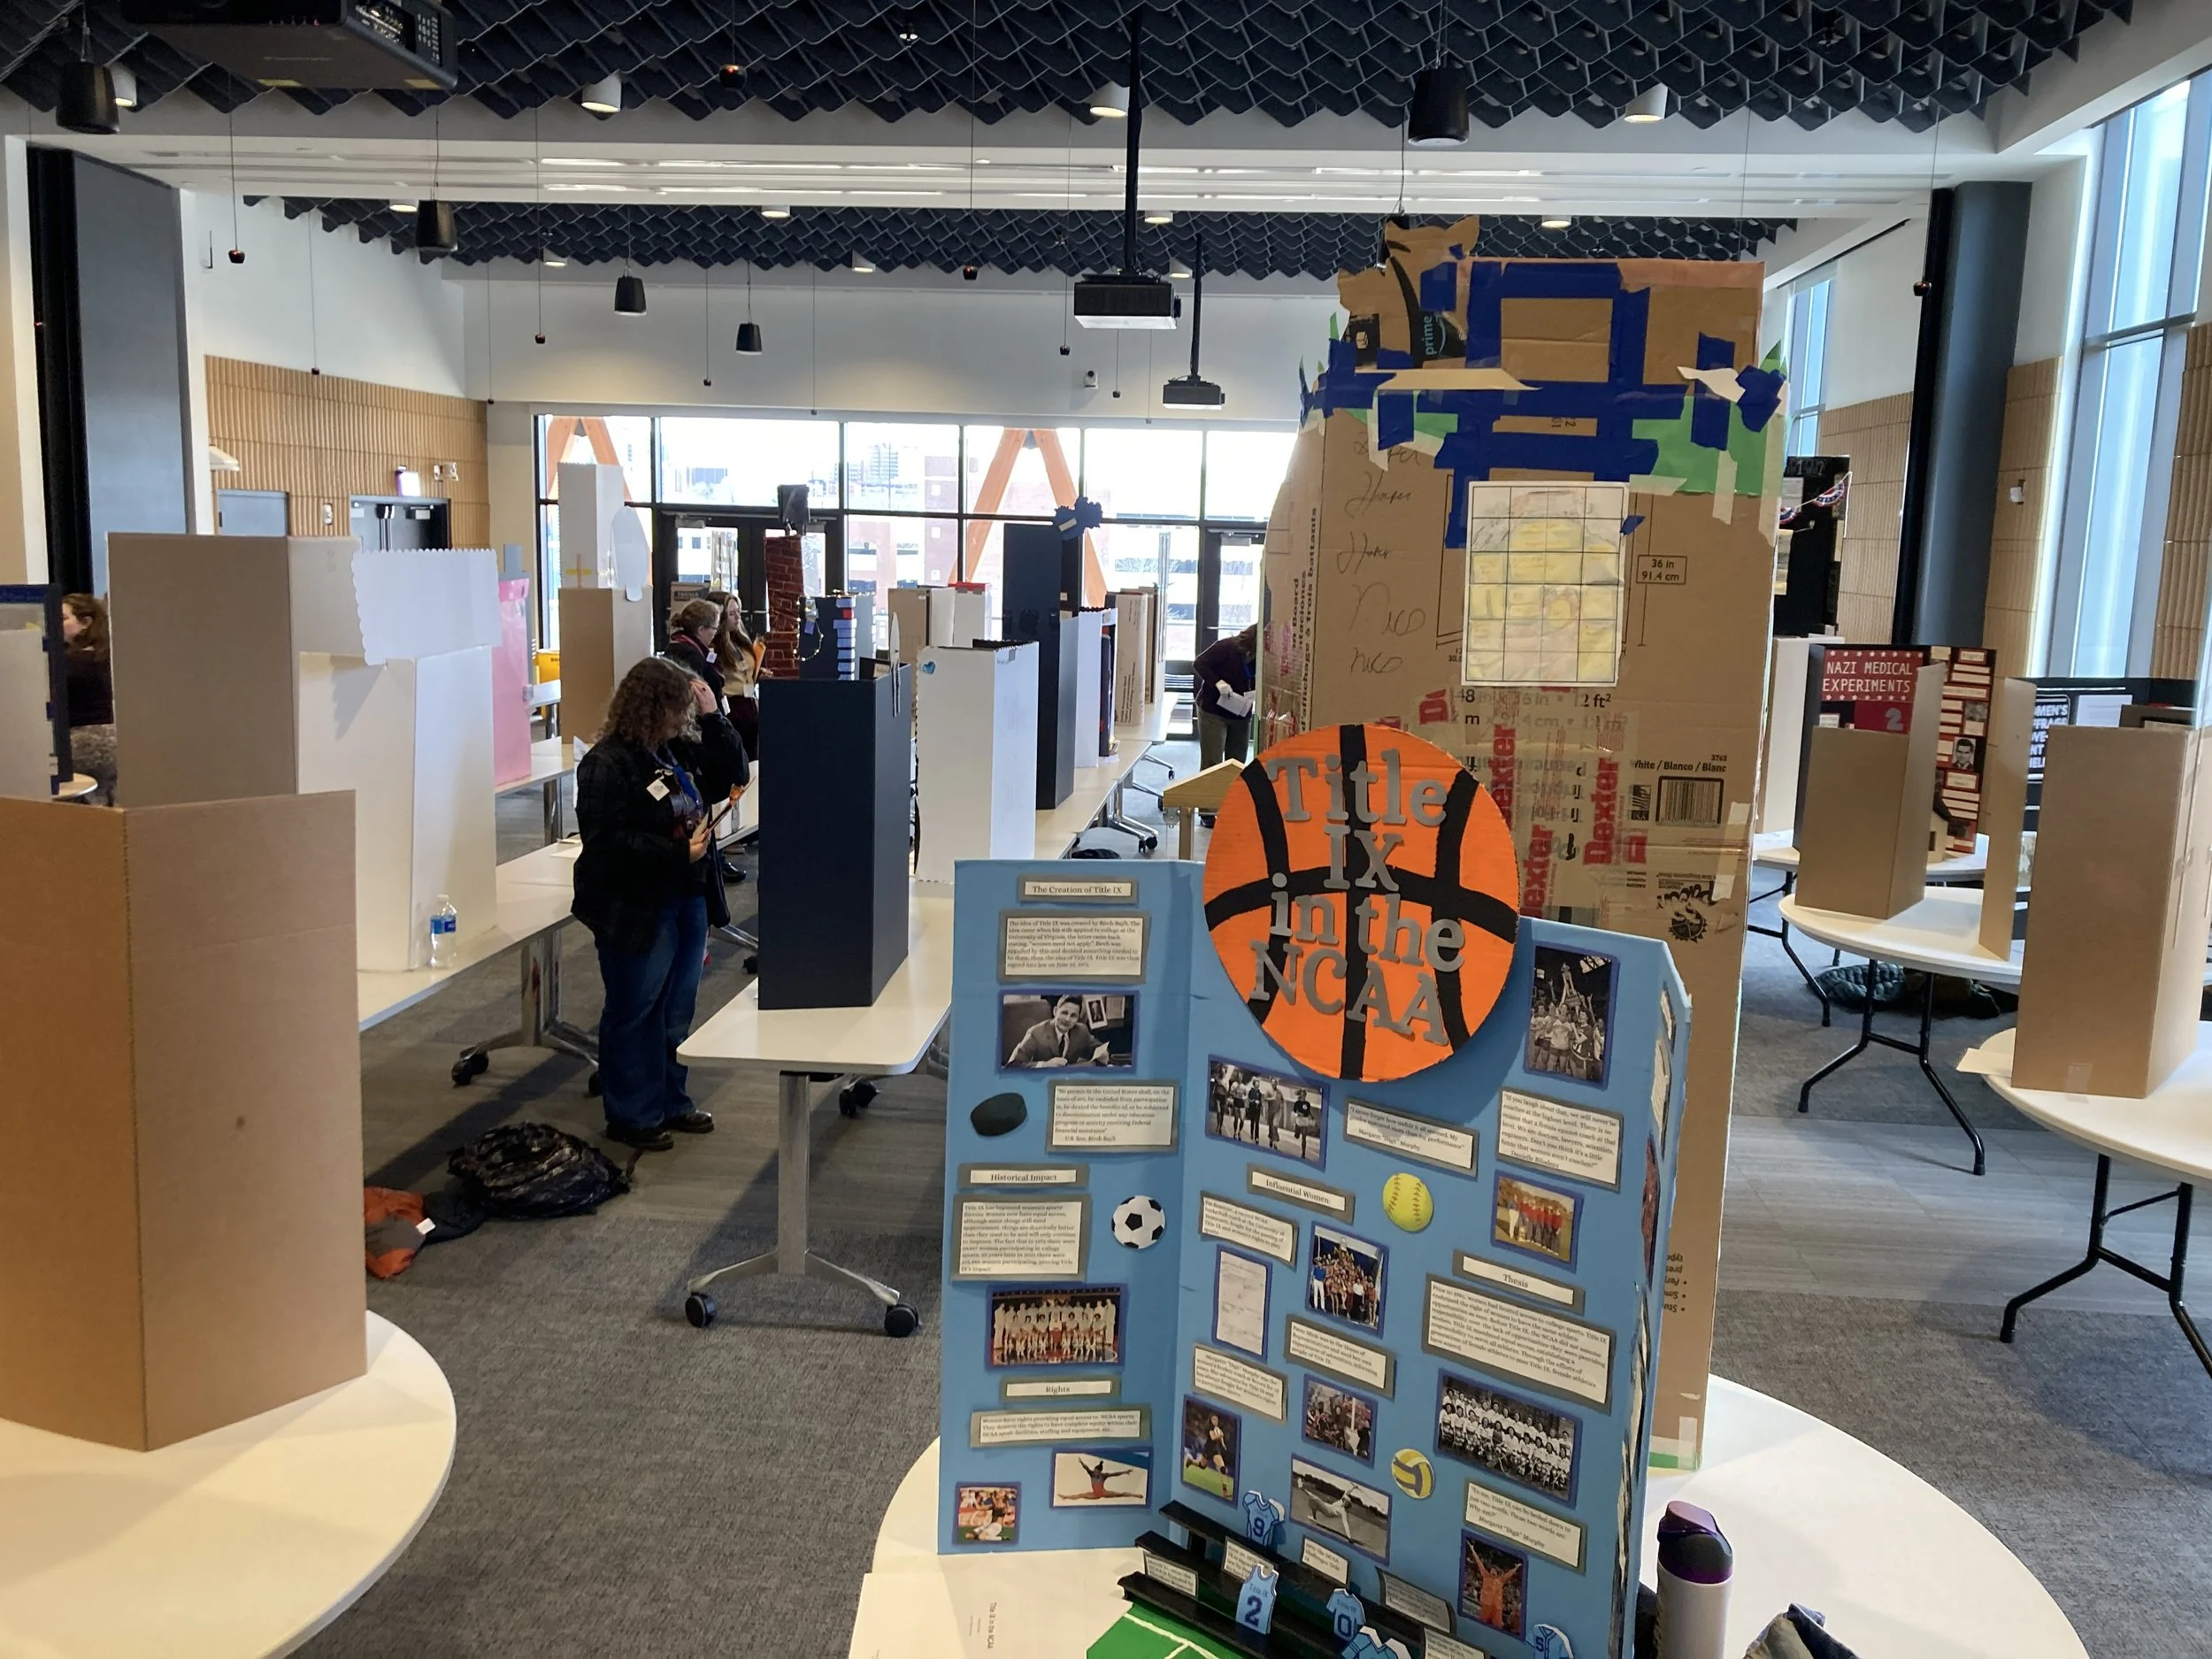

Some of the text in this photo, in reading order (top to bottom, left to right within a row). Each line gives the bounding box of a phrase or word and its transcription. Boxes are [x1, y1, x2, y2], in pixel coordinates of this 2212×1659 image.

[1422, 315, 1437, 356] prime
[1307, 507, 1317, 577] battants
[1651, 559, 1675, 569] 36 in
[1641, 571, 1662, 581] 91.4
[1826, 661, 1914, 675] NAZI MEDICAL
[1822, 678, 1910, 693] EXPERIMENTS
[1885, 707, 1904, 731] 2
[2034, 704, 2069, 717] MEN'S
[1491, 724, 1516, 829] exter
[1663, 761, 1694, 772] Blanco
[1701, 762, 1727, 772] Blanc
[1267, 748, 1448, 827] Title
[1583, 757, 1619, 865] Dexter
[1323, 824, 1404, 893] IX
[1268, 872, 1465, 973] in the
[1248, 940, 1449, 1047] NCAA
[990, 1173, 1057, 1183] Historical Impact
[1265, 1179, 1302, 1197] Influential
[1502, 1273, 1528, 1288] Thesis
[1045, 1385, 1071, 1394] Rights
[1253, 1517, 1265, 1537] 9
[1244, 1595, 1263, 1626] 2
